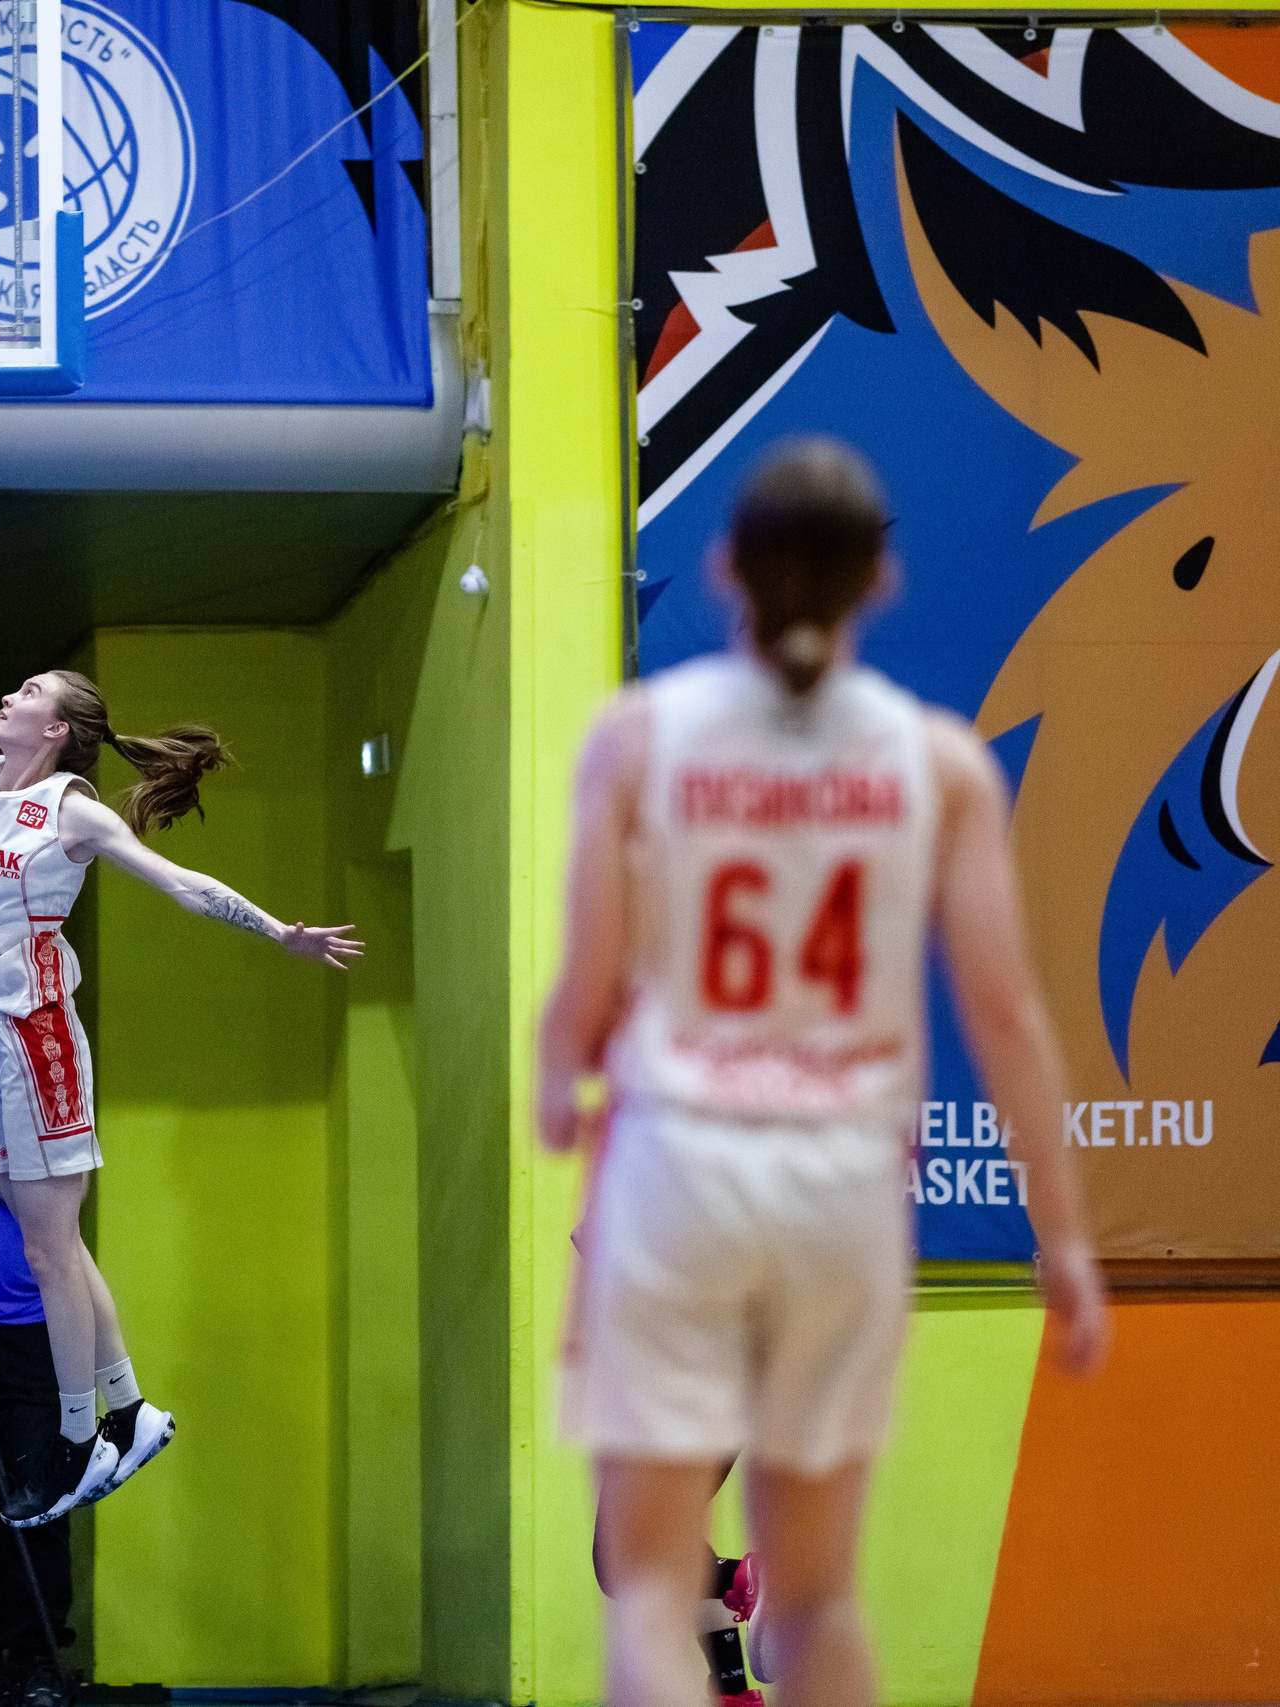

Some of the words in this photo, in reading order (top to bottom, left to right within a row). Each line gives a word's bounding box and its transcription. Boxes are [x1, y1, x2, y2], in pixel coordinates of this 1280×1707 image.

[84, 219, 161, 297] БЛАСТЬ
[18, 811, 44, 827] BET
[21, 803, 47, 818] FON
[696, 857, 868, 1016] 64
[904, 1157, 1028, 1206] ASKET
